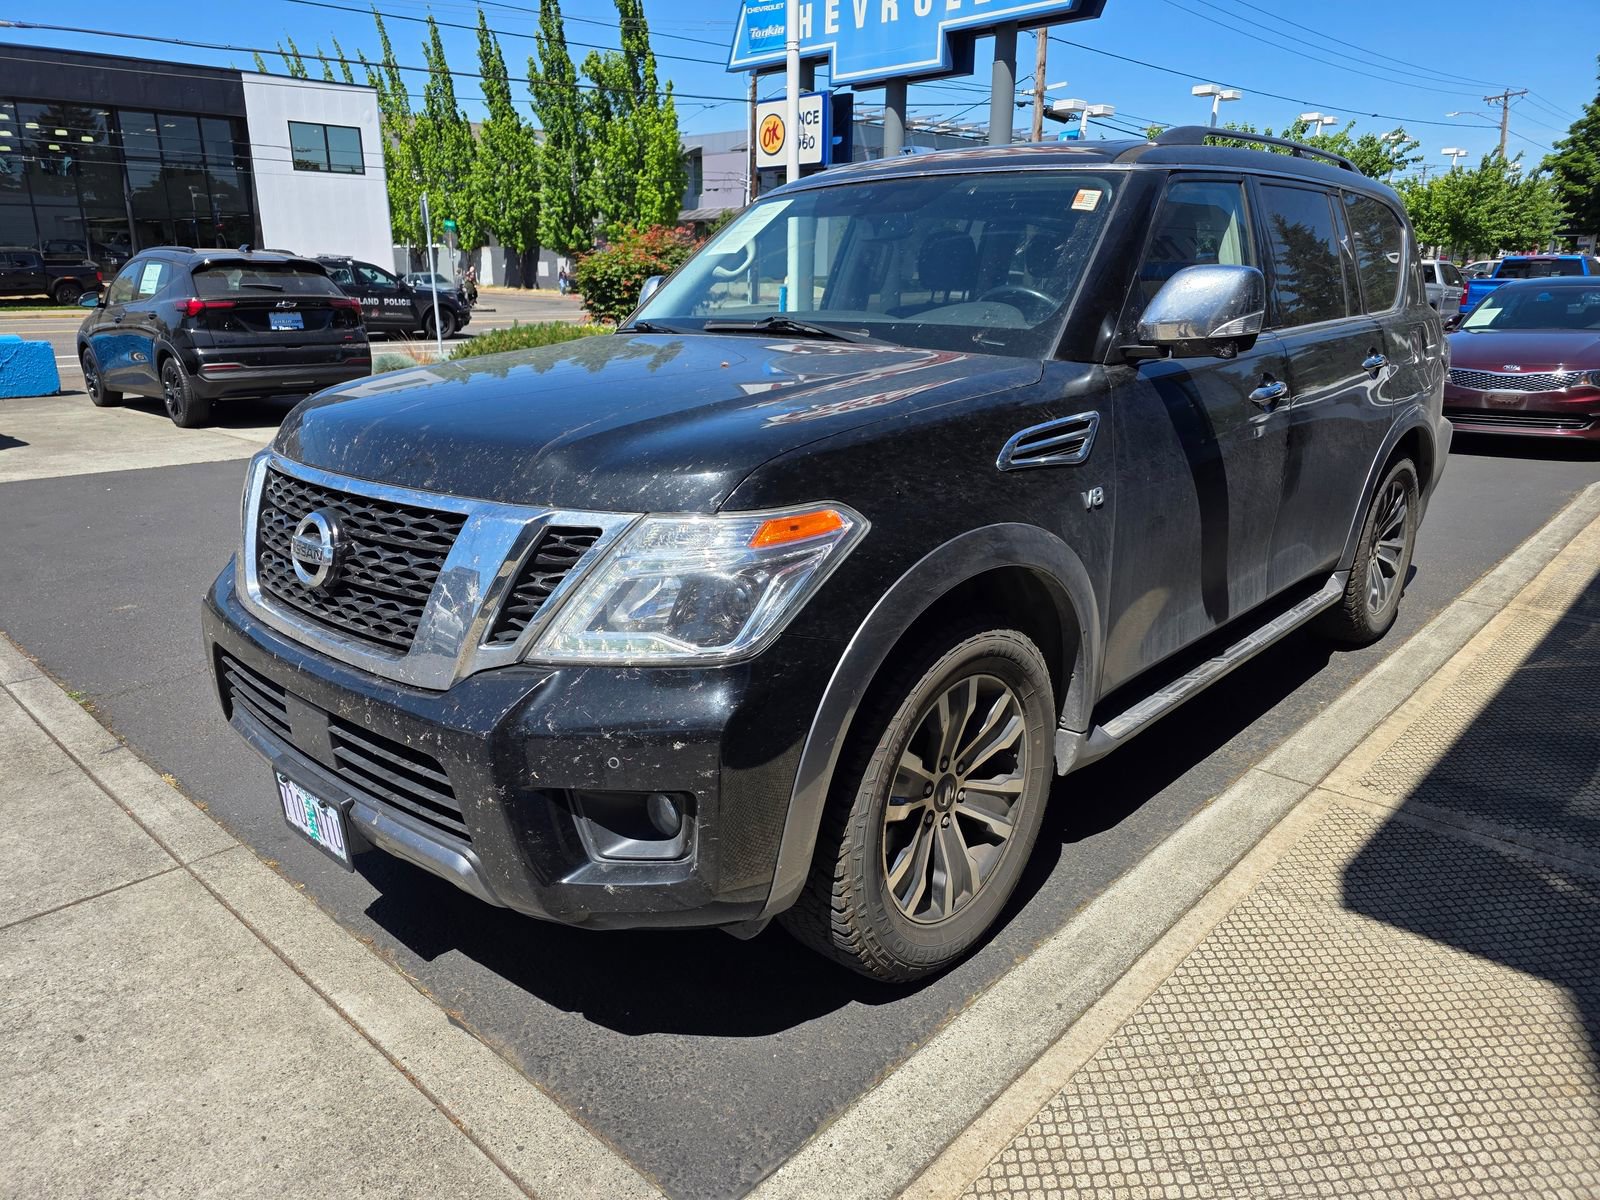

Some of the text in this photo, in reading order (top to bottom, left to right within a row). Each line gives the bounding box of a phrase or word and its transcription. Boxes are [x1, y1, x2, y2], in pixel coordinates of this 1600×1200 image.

[747, 3, 784, 14] CHEVROLET
[799, 0, 991, 39] HEVR
[750, 24, 785, 38] Tonkin
[799, 110, 820, 125] NCE
[763, 121, 781, 148] OK
[357, 297, 411, 306] LAND POLICE
[1080, 487, 1104, 508] V8
[293, 542, 324, 561] SSAN
